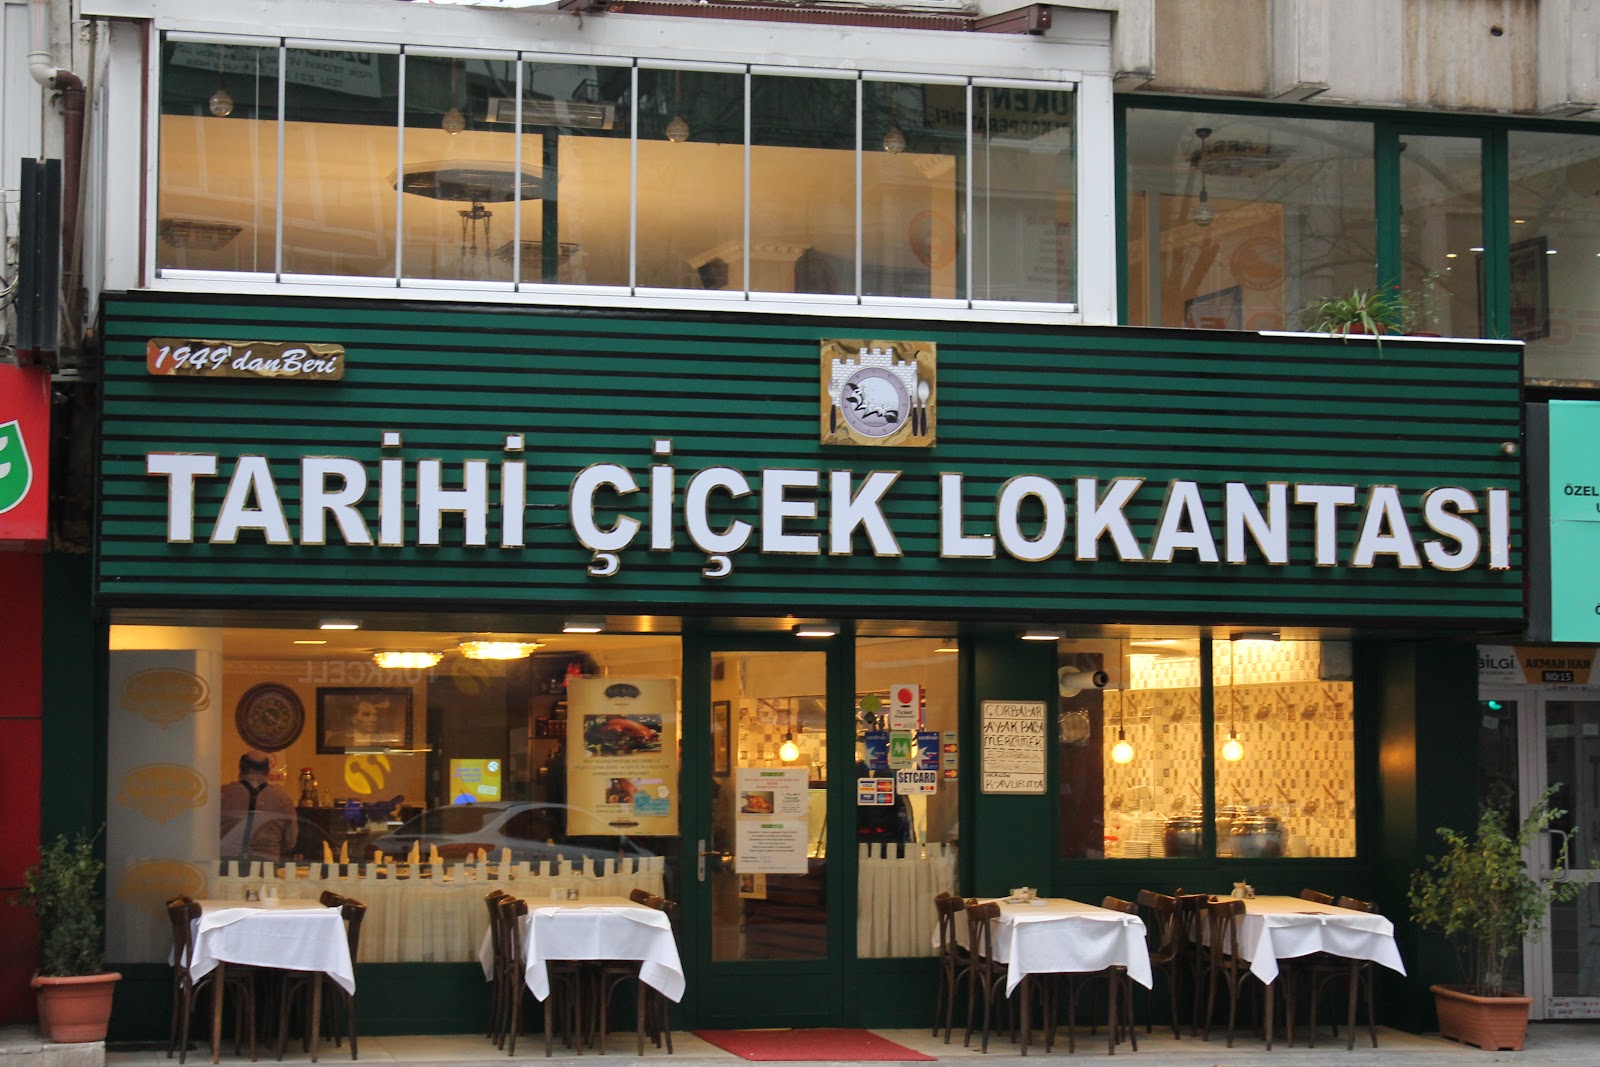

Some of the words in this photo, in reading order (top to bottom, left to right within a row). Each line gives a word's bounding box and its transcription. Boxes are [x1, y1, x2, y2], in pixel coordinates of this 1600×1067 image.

[1564, 483, 1599, 497] ÖZEL
[145, 430, 527, 549] TARİHİ
[569, 437, 904, 579] ÇİÇEK
[938, 470, 1511, 573] LOKANTASI
[1525, 658, 1566, 669] AKMAN
[1567, 659, 1592, 669] HAN
[1545, 672, 1572, 682] NO:15
[898, 772, 936, 784] SETCARD
